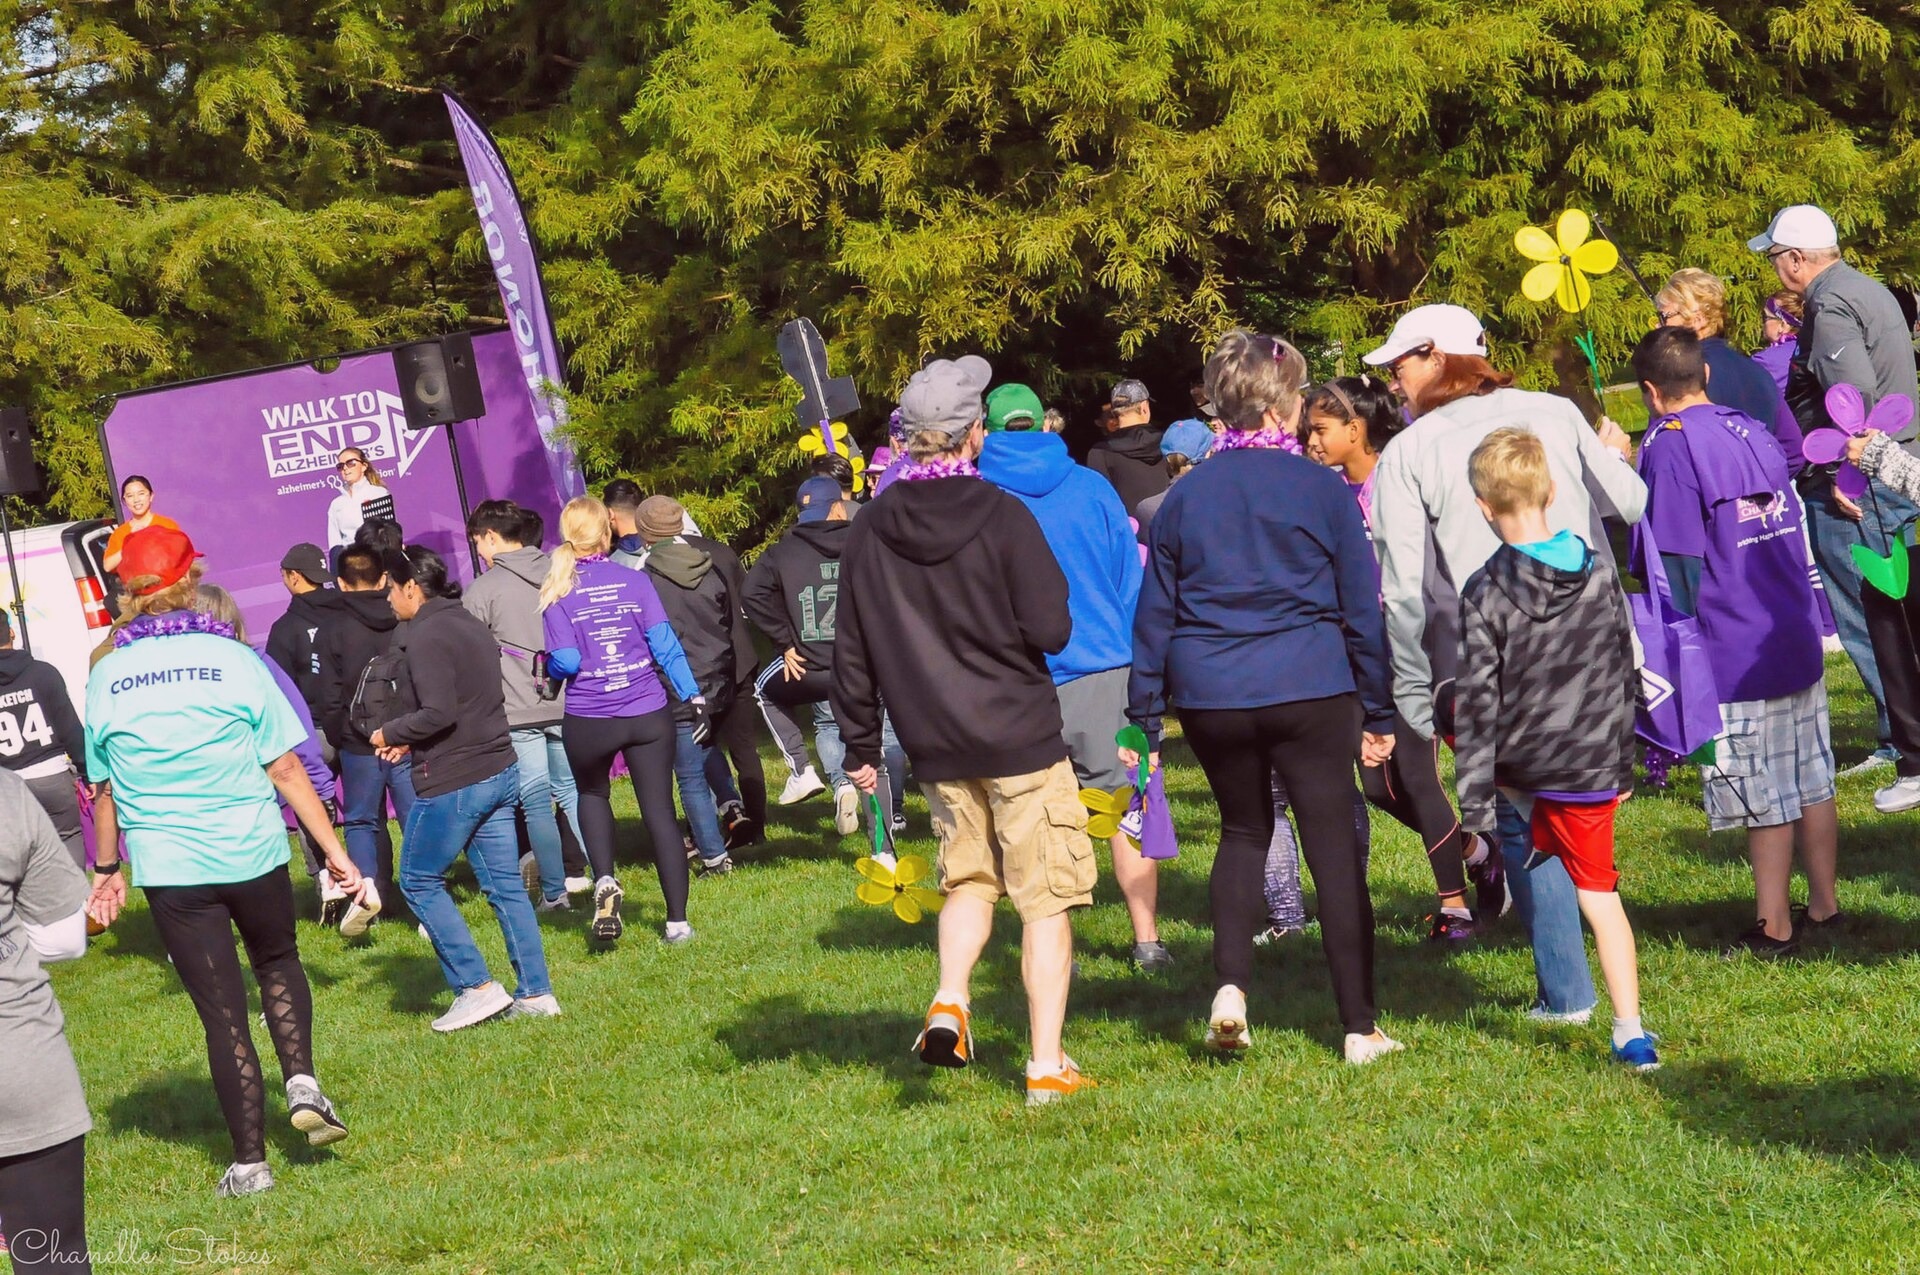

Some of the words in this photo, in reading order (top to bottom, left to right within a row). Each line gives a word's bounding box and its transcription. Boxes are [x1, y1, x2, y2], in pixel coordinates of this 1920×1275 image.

[261, 396, 339, 430] WALK
[340, 391, 377, 417] TO
[269, 420, 381, 460] END
[274, 445, 385, 474] ALZHEIR'S
[277, 480, 326, 496] alzheimer's
[110, 667, 222, 695] COMMITTEE
[0, 702, 54, 756] 94
